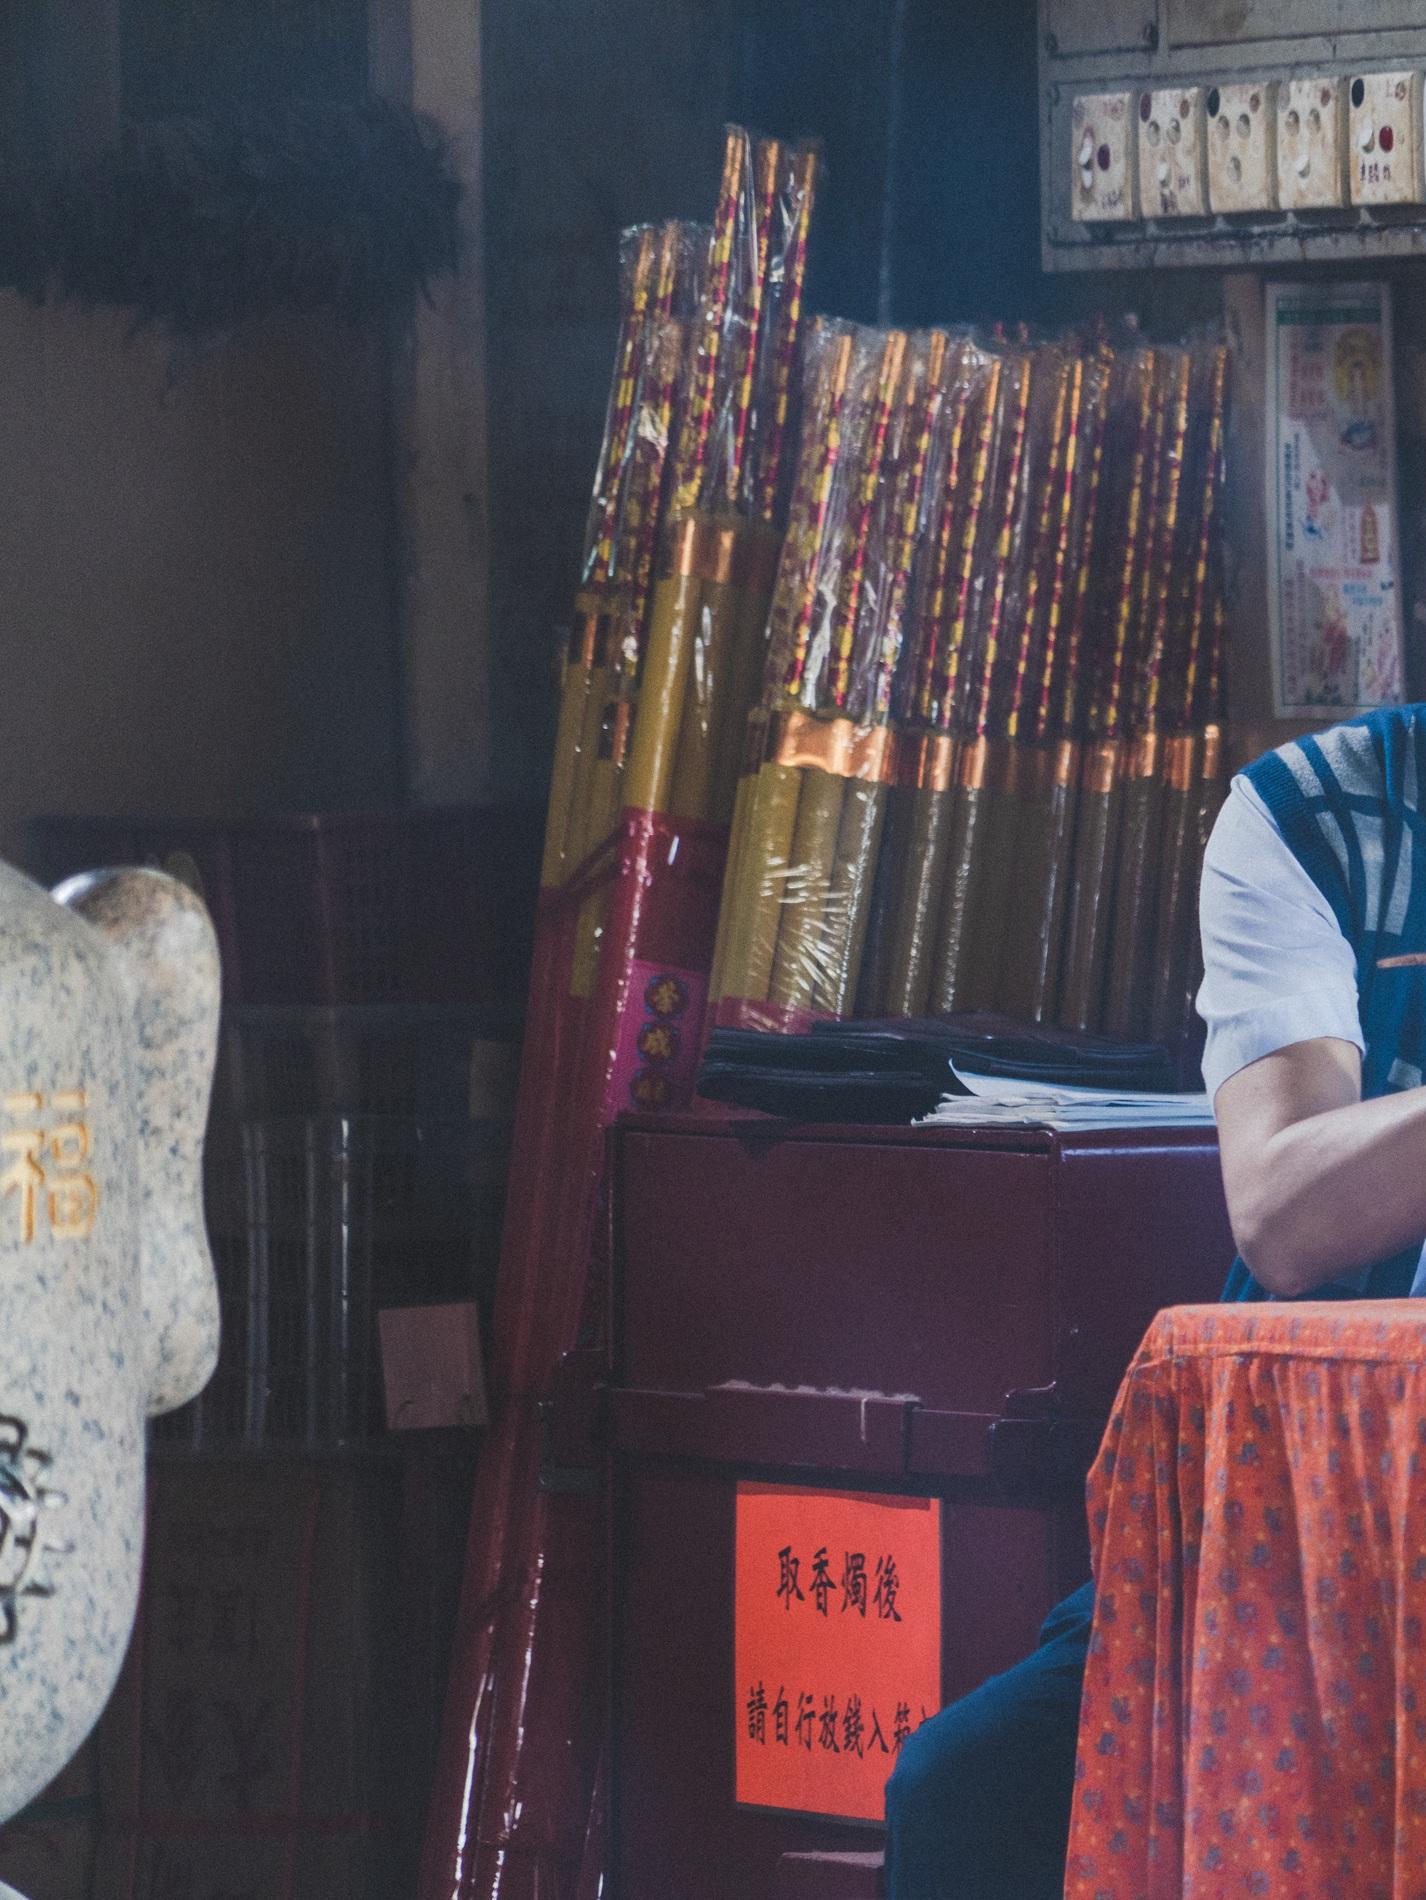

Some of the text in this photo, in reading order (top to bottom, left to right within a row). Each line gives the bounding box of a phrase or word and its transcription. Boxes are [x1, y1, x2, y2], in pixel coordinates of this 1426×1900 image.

[775, 1545, 902, 1622] 取香燭後
[746, 1680, 927, 1760] 請自行放錢入箱
